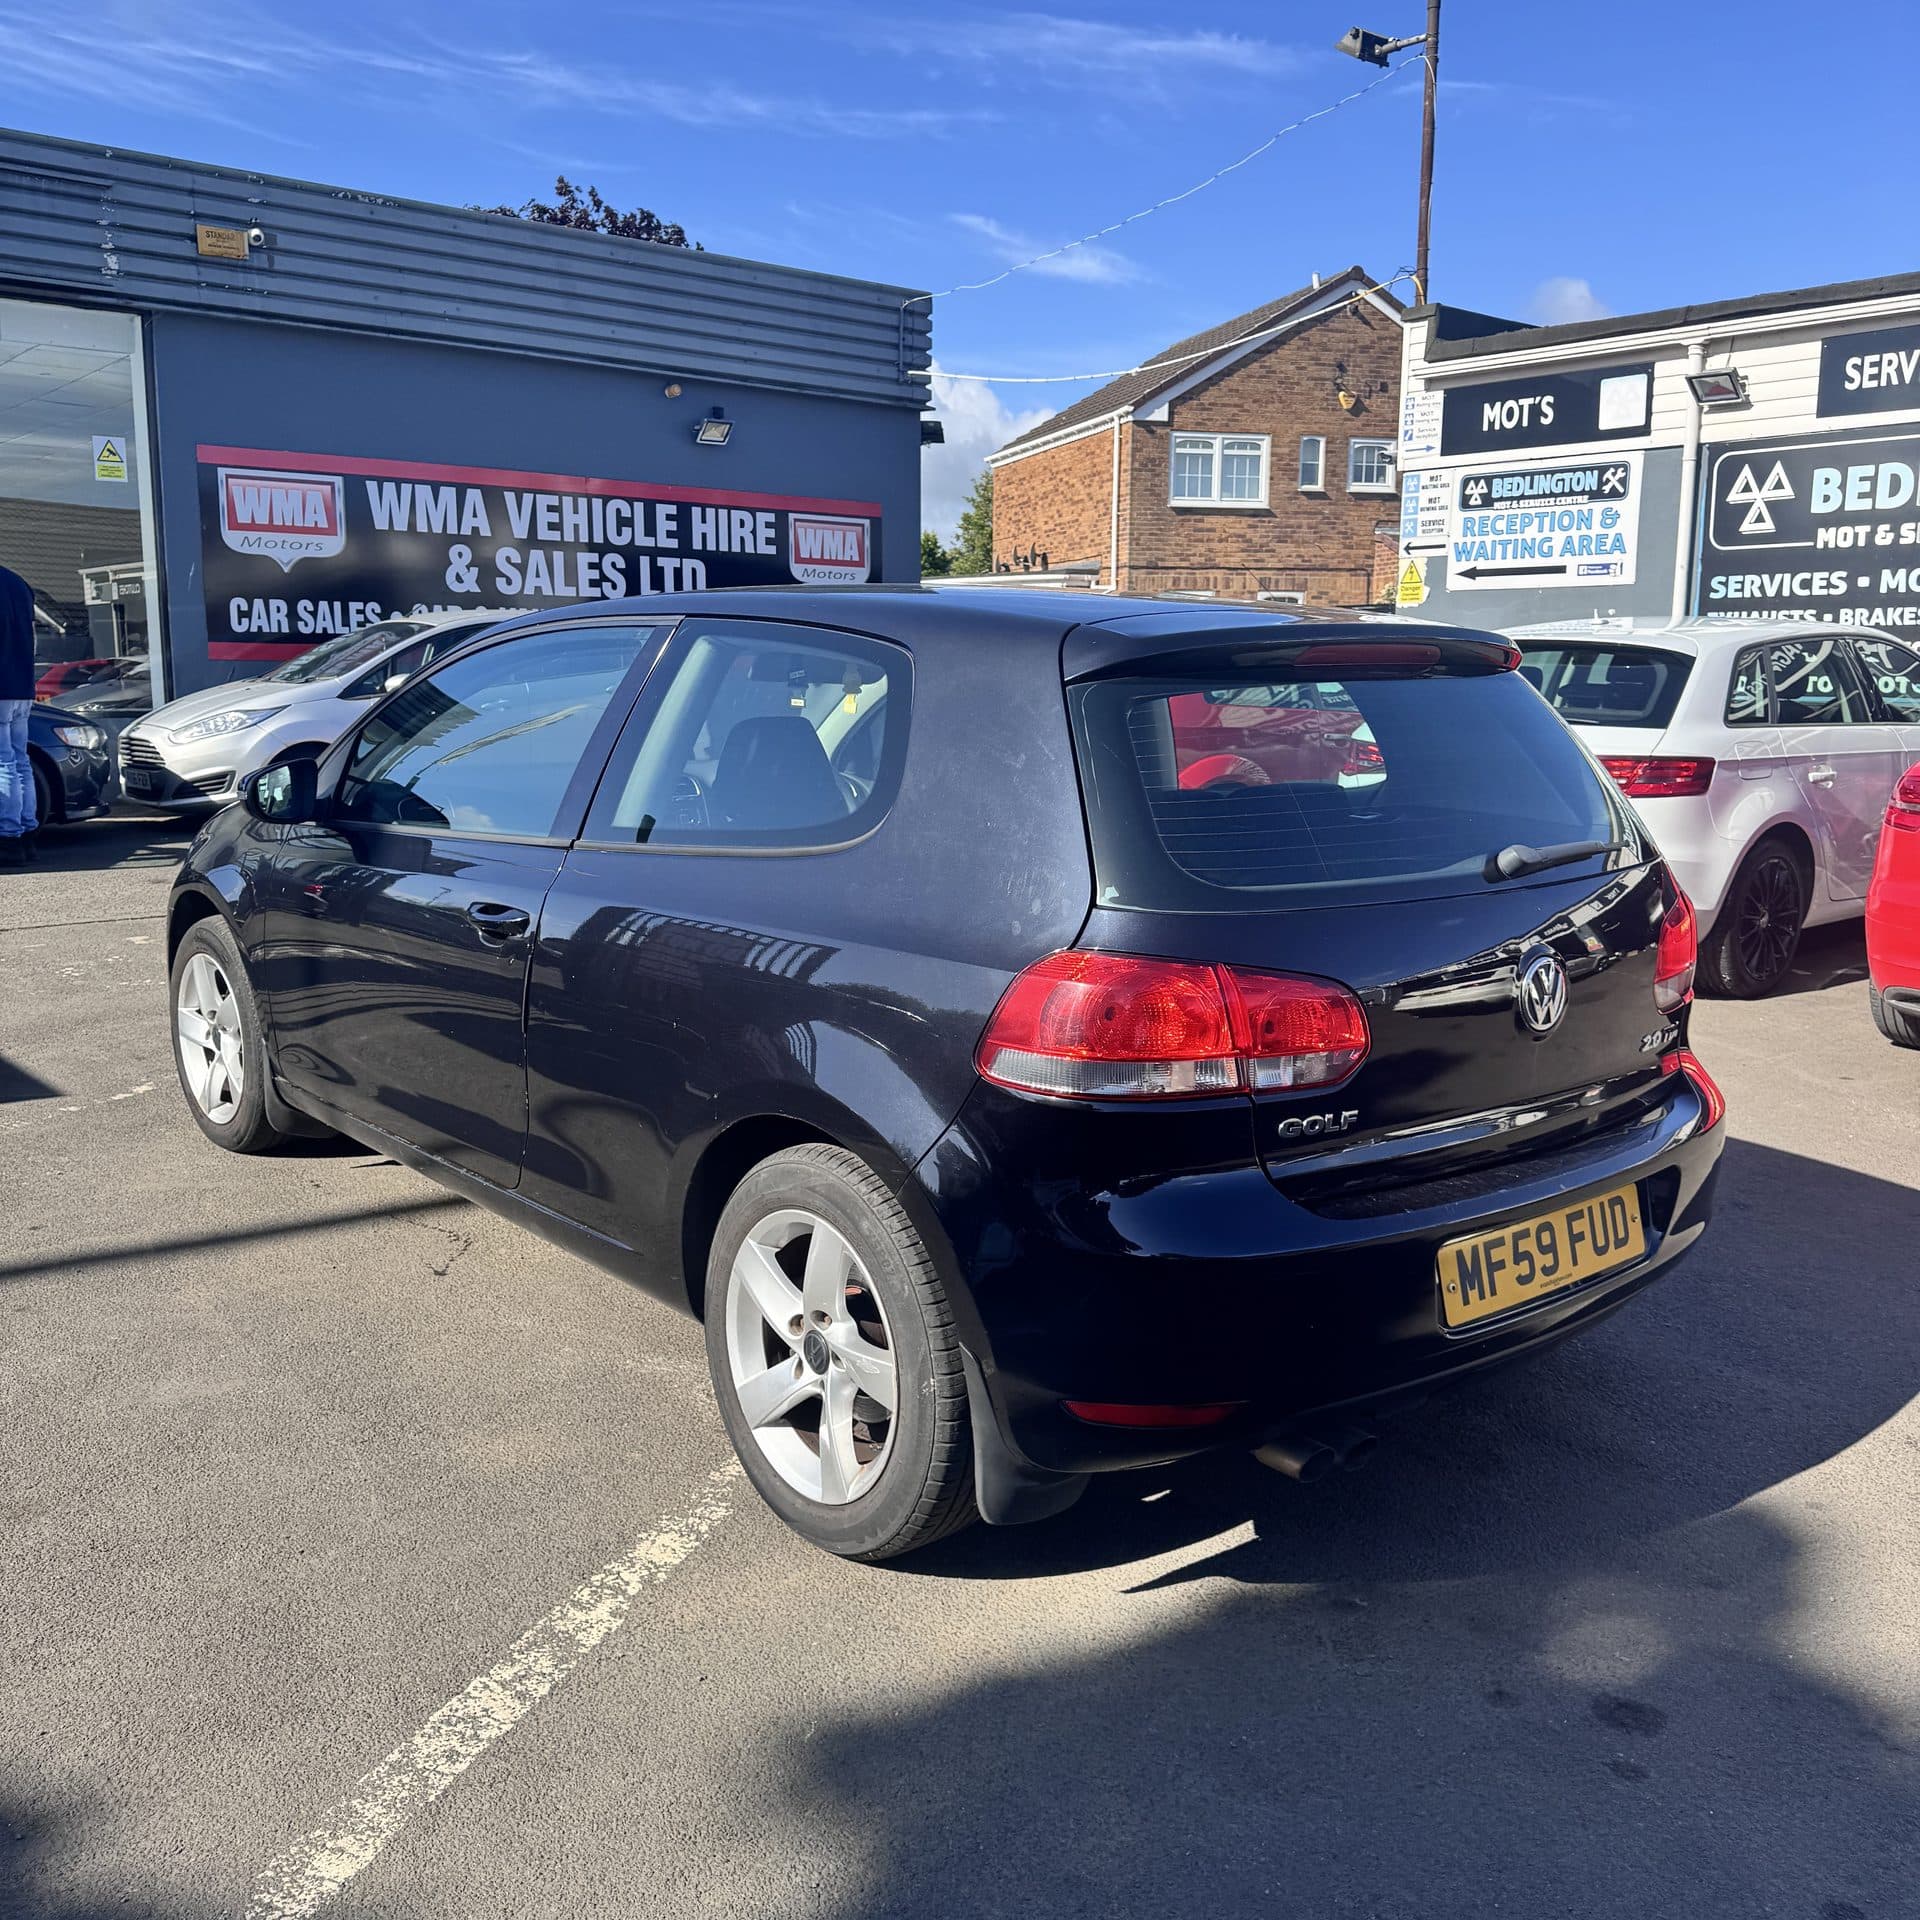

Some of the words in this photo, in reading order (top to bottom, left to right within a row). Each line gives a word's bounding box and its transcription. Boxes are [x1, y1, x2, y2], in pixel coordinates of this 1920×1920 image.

[1844, 349, 1920, 390] SERV
[1482, 395, 1554, 432] MOT'S
[1491, 469, 1600, 499] BEDLINGTON
[1810, 462, 1920, 515] BED
[231, 485, 329, 529] WMA
[365, 480, 491, 537] WMA
[503, 491, 678, 549] VEHICLE
[691, 505, 777, 555] HIRE
[1462, 508, 1593, 538] RECEPTION
[1600, 507, 1621, 529] &
[240, 536, 325, 552] Motors
[797, 527, 860, 562] WMA
[1453, 537, 1554, 563] WAITING
[1559, 533, 1627, 558] AREA
[1816, 524, 1871, 549] MOT
[1874, 524, 1895, 547] &
[1900, 522, 1920, 545] S
[445, 543, 482, 593] &
[495, 546, 627, 600] SALES
[639, 555, 708, 595] LTD
[801, 568, 857, 581] Motors
[1709, 571, 1848, 599] SERVICES
[229, 597, 290, 634] CAR
[296, 598, 384, 635] SALES
[1839, 607, 1920, 626] BRAKE
[1278, 1109, 1359, 1138] GOLF
[1455, 1220, 1560, 1307] MF59
[1565, 1195, 1630, 1268] FUD
